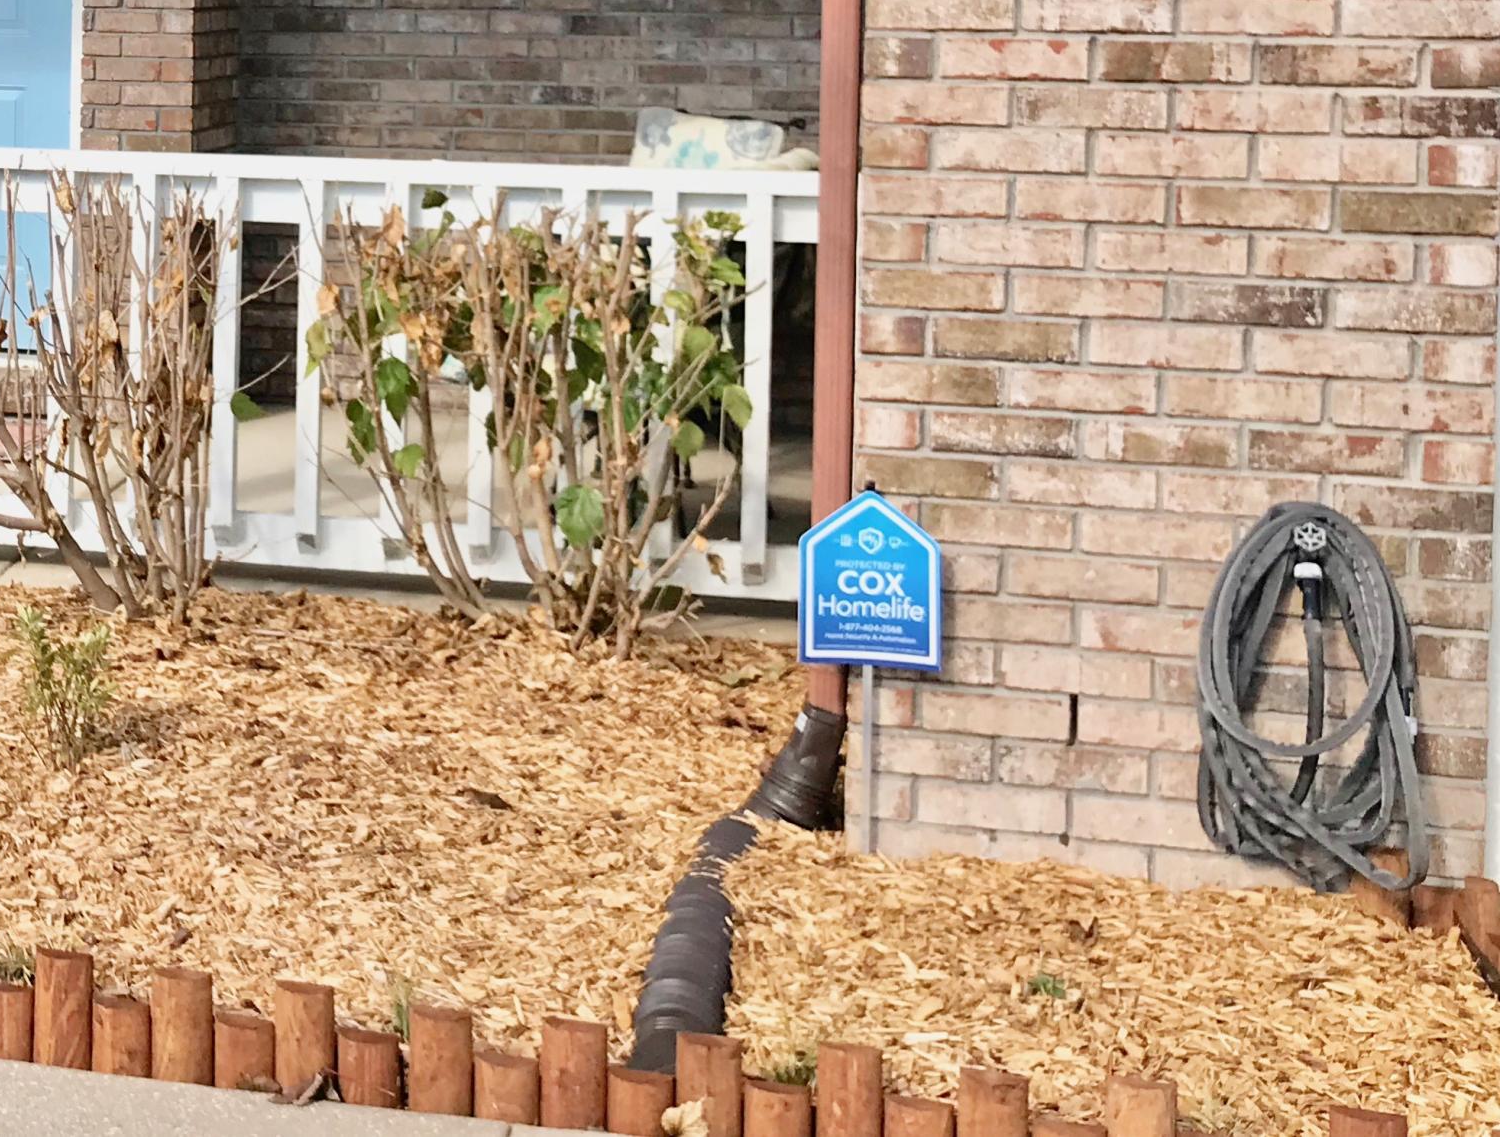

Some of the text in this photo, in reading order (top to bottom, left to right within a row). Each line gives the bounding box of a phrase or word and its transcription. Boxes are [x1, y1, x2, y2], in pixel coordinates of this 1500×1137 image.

[835, 559, 906, 571] PROTECTED BY
[837, 569, 905, 597] COX
[818, 593, 925, 622] Homelife
